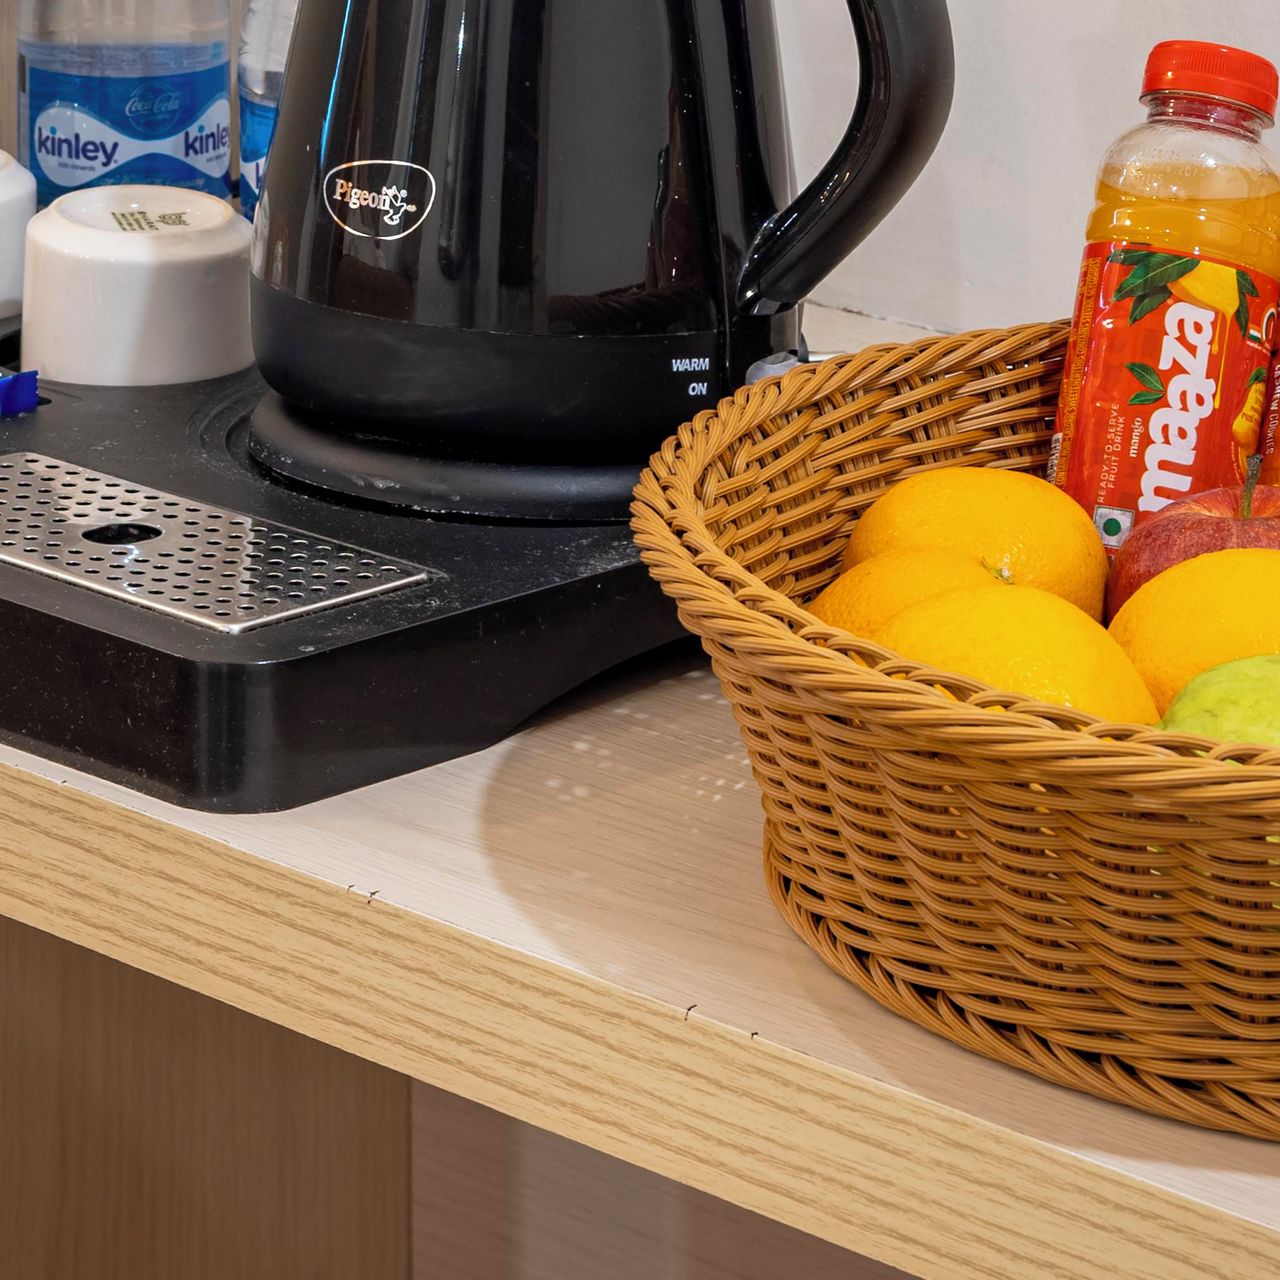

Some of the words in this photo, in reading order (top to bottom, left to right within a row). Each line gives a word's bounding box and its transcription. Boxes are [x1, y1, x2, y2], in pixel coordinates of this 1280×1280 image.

[38, 126, 119, 167] kinley
[184, 123, 230, 158] kinle
[333, 178, 391, 210] Pigeon
[672, 358, 710, 371] WARM
[688, 382, 708, 395] ON
[1137, 301, 1217, 513] maaza
[1098, 403, 1120, 503] READY-TO-SERVE
[1107, 456, 1119, 488] FRUIT
[1113, 416, 1126, 451] DRINK
[1129, 417, 1145, 458] mango
[1265, 411, 1279, 455] COOKIES
